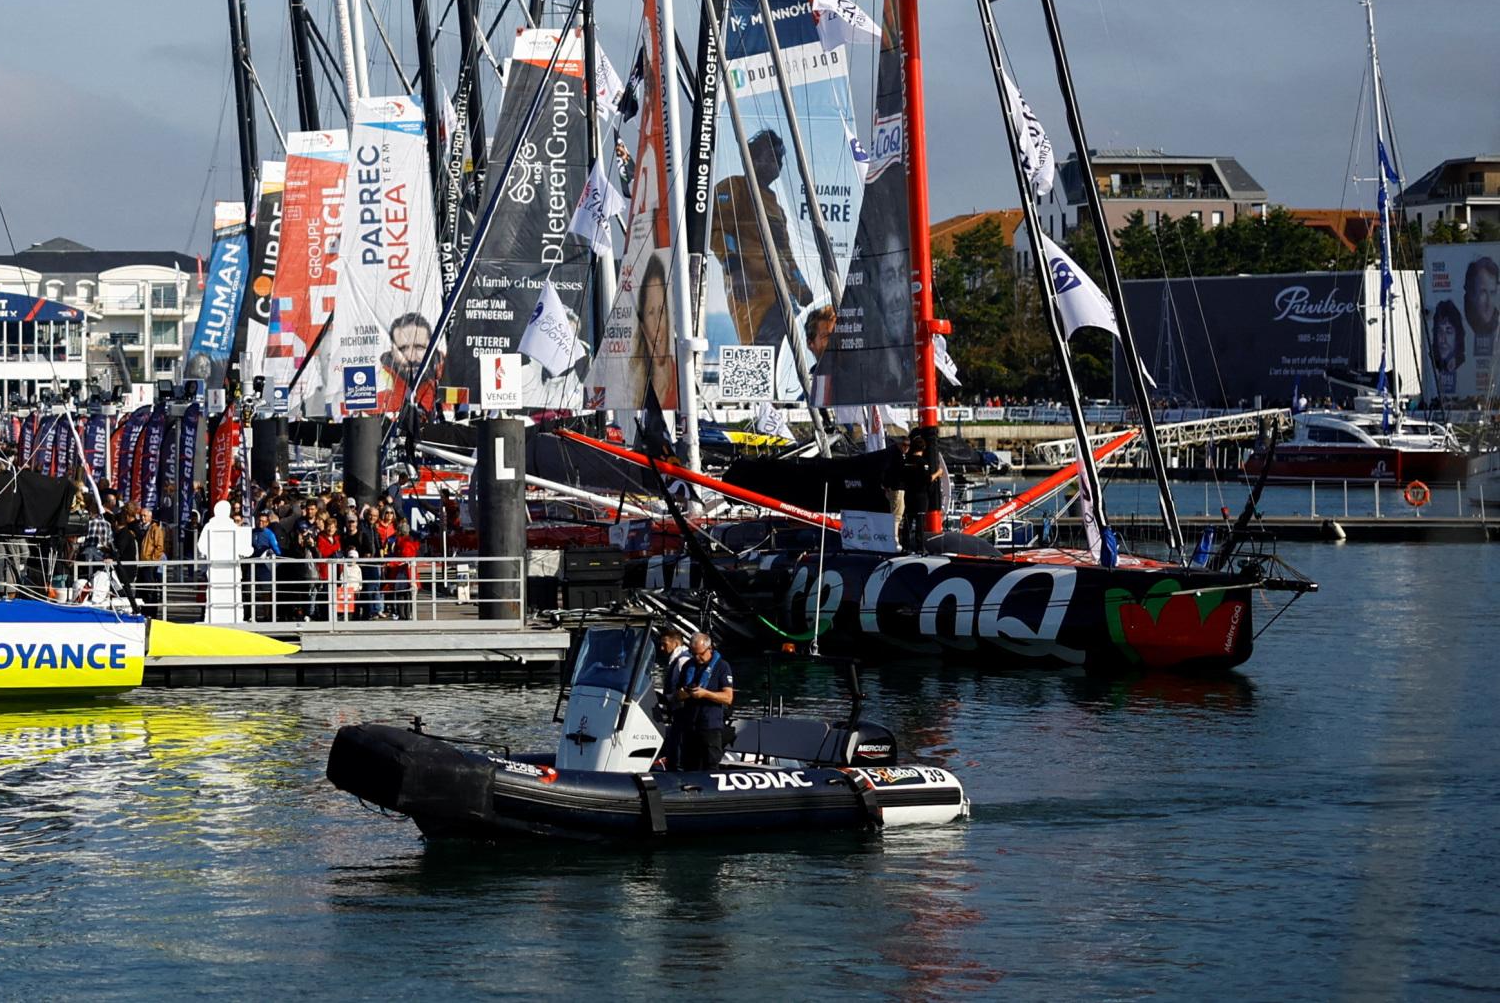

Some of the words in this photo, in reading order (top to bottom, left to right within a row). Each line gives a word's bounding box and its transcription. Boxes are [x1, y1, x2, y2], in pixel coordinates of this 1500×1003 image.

[699, 99, 714, 161] FURTHER
[383, 143, 391, 182] TEAM
[696, 163, 708, 214] GOING
[357, 145, 384, 265] PAPREC
[307, 217, 320, 279] GROUPE
[472, 276, 482, 287] A
[482, 275, 512, 290] family
[514, 276, 526, 288] of
[201, 243, 241, 348] HUMAN
[465, 299, 488, 309] DENIS
[489, 299, 506, 309] VAN
[1273, 286, 1355, 323] Privilège
[465, 309, 513, 321] WEYNBERGH
[612, 307, 632, 319] TEAM
[354, 326, 380, 336] YOANN
[340, 336, 380, 346] RICHOMME
[466, 336, 510, 347] D'IETEREN
[341, 356, 376, 364] PAPREC
[486, 392, 517, 400] VENDÉE
[495, 437, 515, 480] L
[857, 744, 891, 753] MERCURY
[710, 770, 814, 791] ZODIAC
[870, 767, 918, 784] Sodebo
[927, 769, 946, 783] 39
